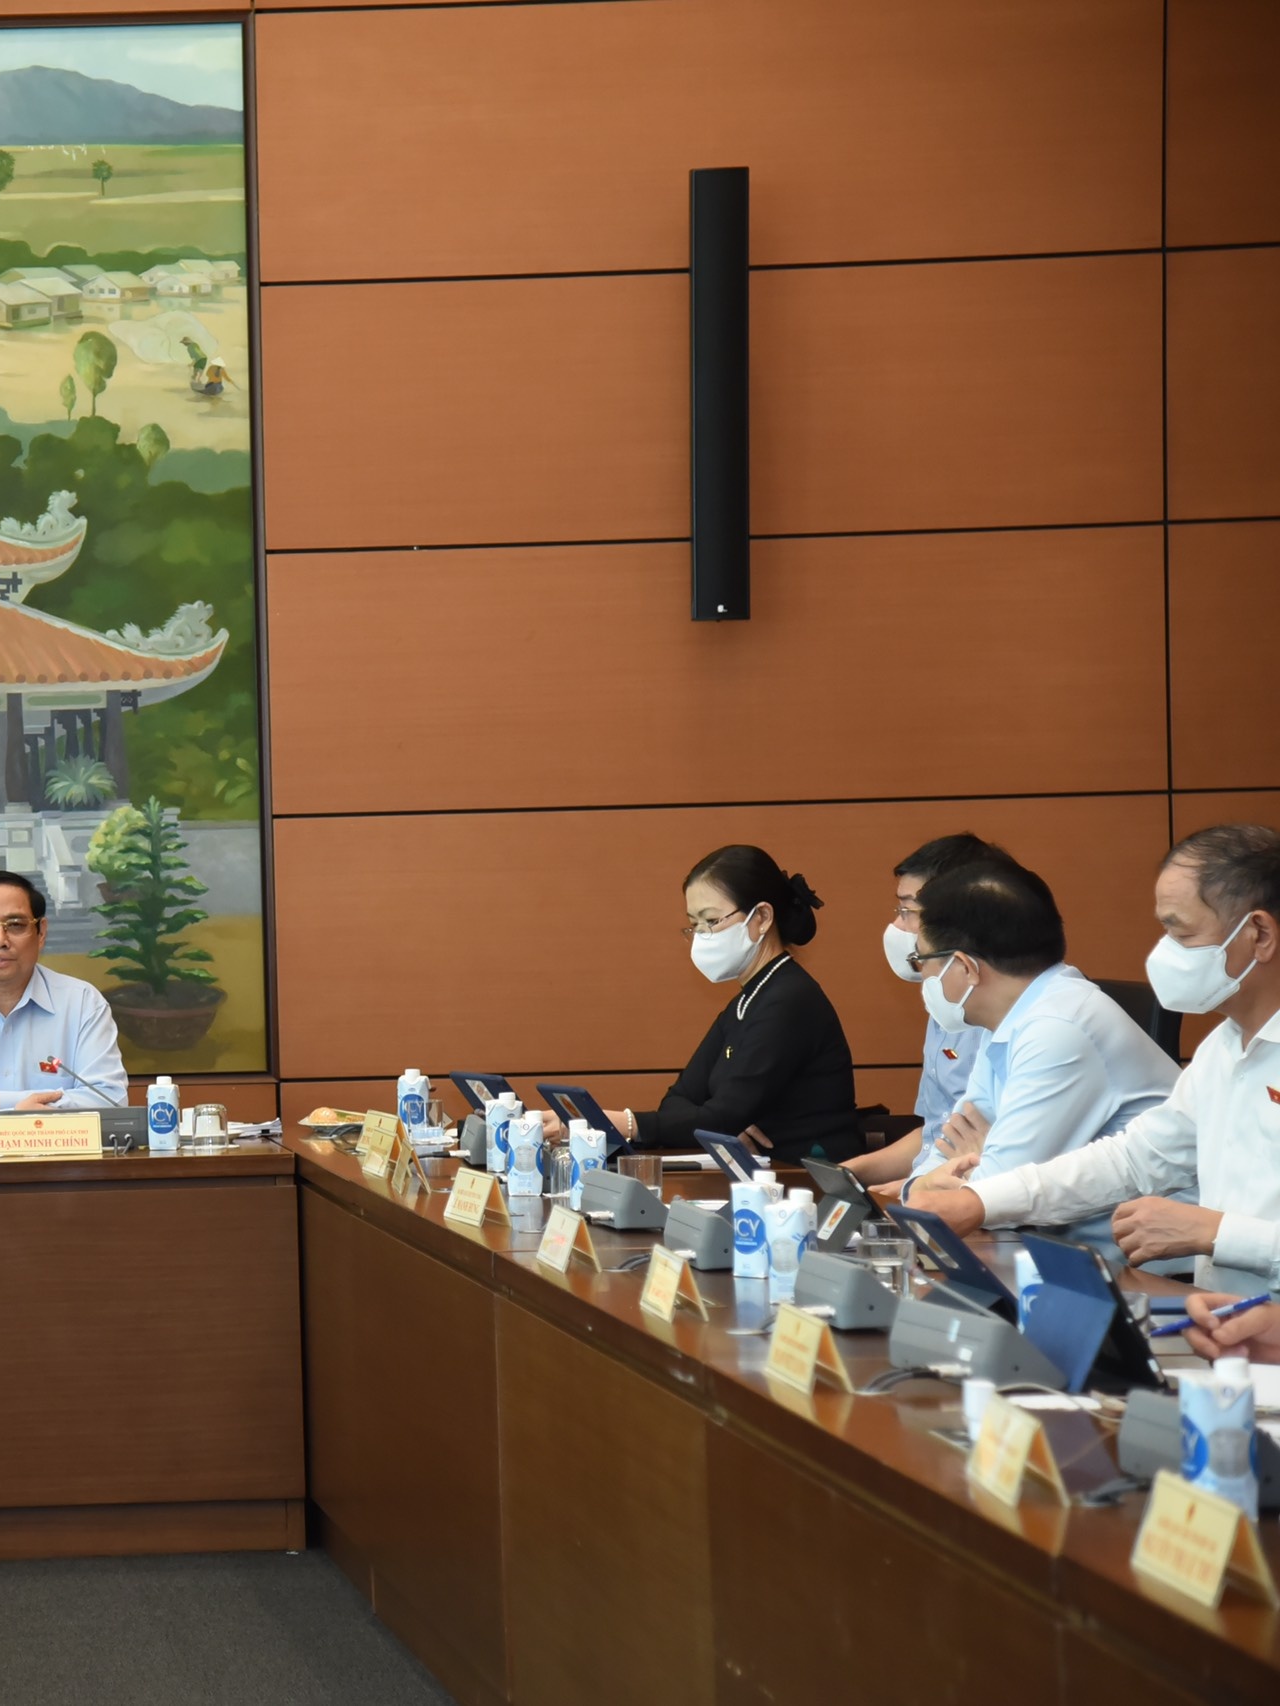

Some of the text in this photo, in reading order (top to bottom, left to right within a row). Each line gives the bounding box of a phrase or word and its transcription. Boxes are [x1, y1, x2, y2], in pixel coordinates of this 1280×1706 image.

[151, 1108, 174, 1122] ICY
[24, 1138, 52, 1148] MINH
[54, 1136, 88, 1147] CHÍNH
